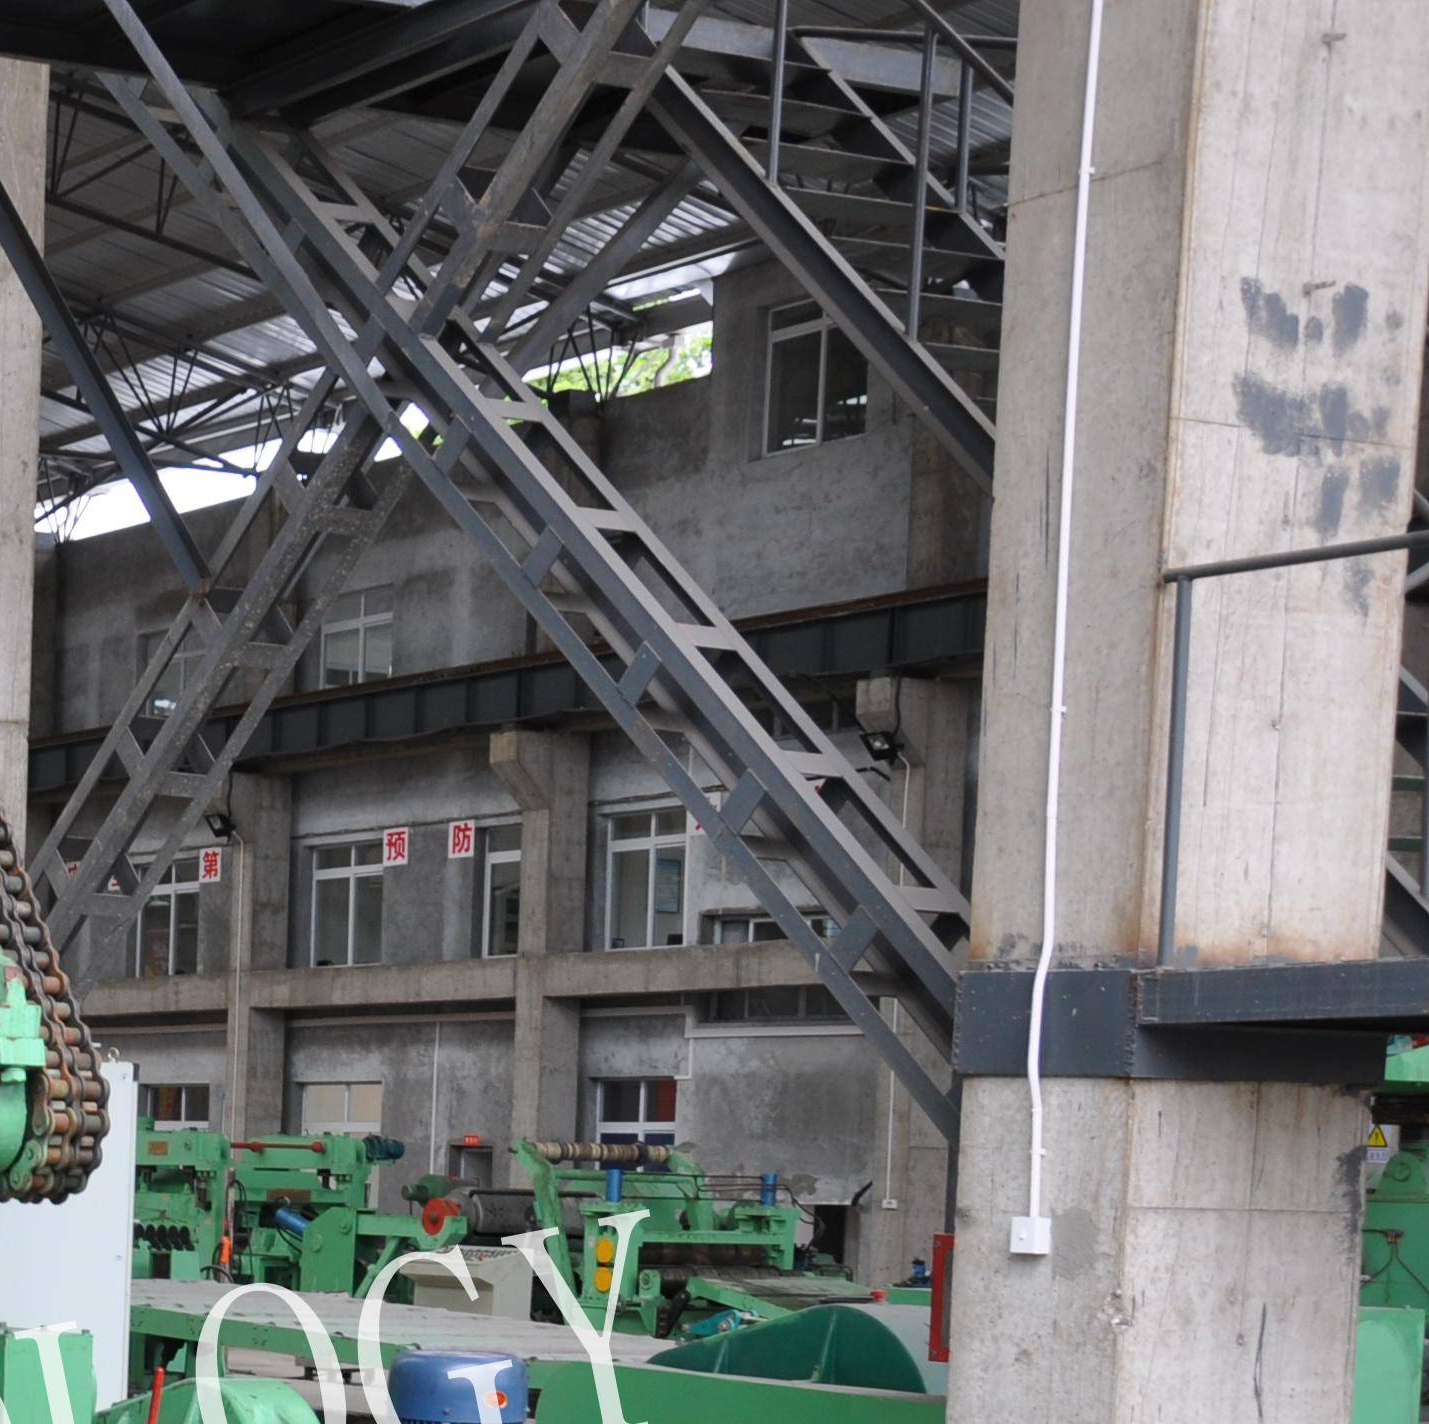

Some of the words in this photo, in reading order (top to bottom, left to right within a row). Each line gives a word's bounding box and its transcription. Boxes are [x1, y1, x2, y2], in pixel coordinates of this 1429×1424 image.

[202, 850, 220, 879] 第
[386, 831, 406, 861] 预
[452, 823, 472, 854] 防
